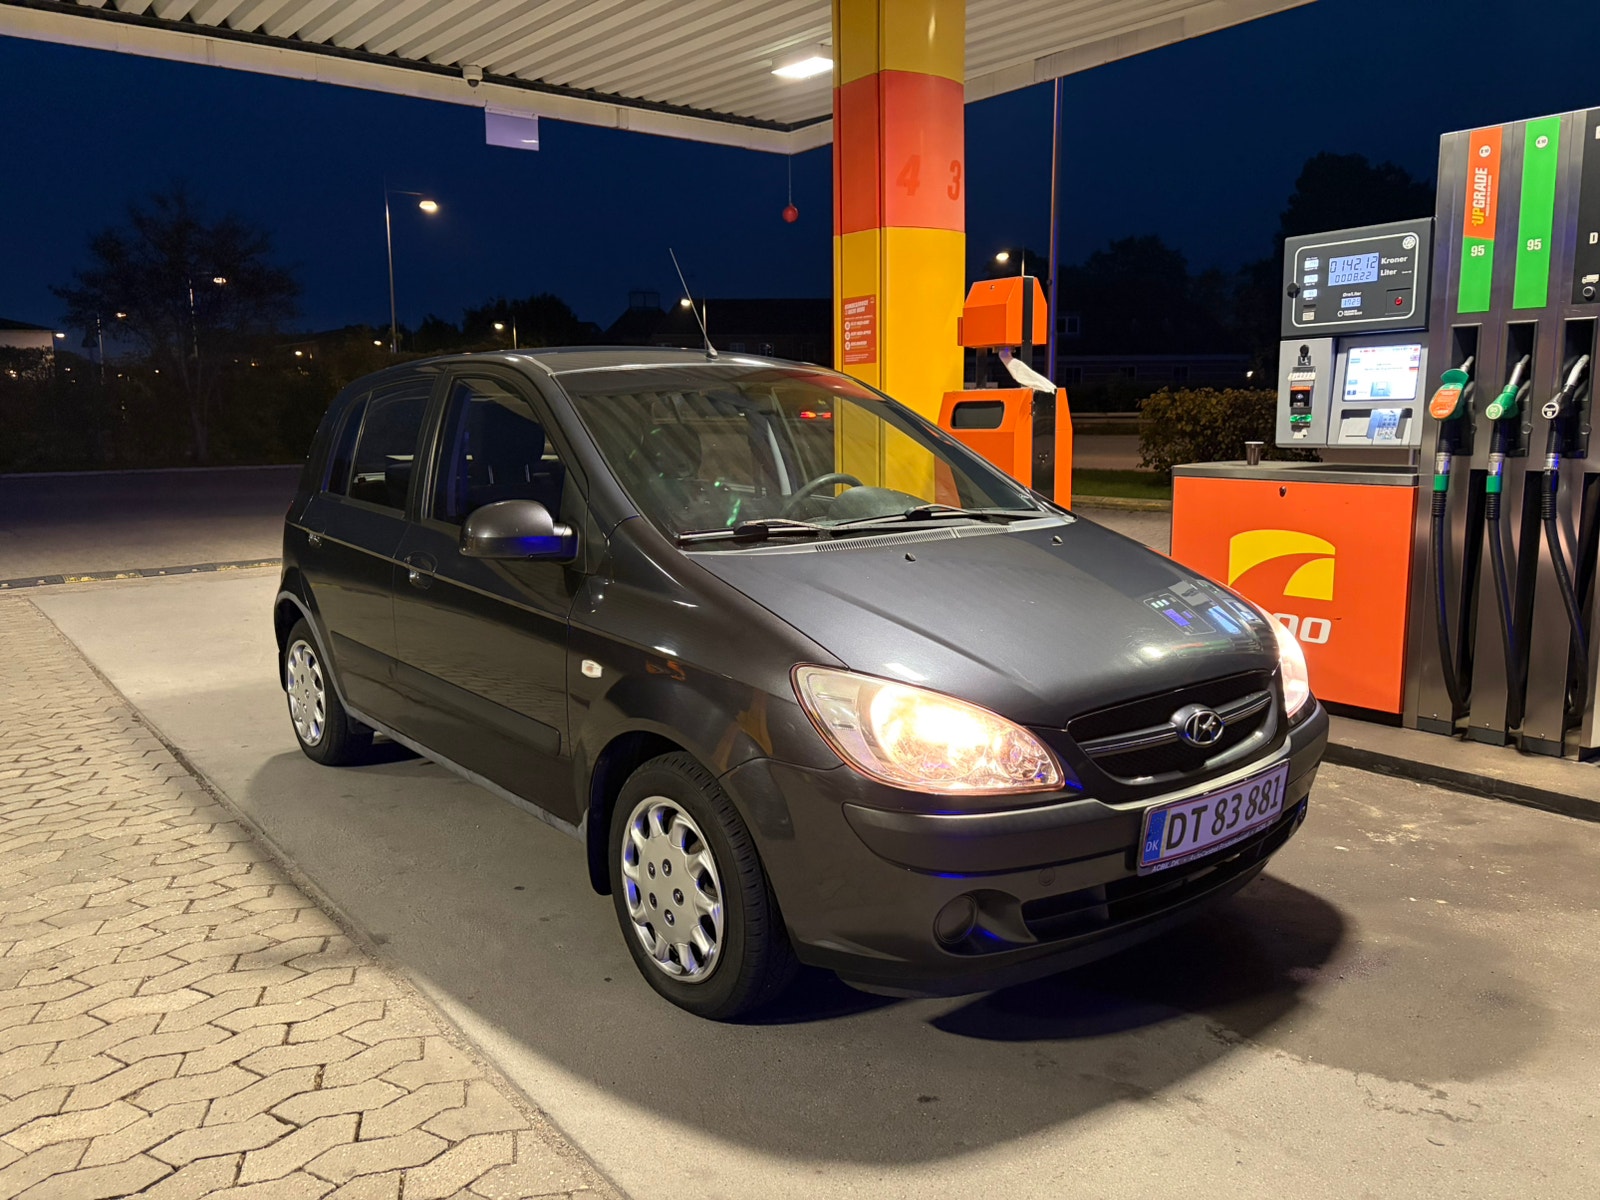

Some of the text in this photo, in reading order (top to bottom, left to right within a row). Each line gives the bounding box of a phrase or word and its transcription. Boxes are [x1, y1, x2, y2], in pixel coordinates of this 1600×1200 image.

[896, 154, 921, 197] 4
[947, 160, 961, 201] 3
[1472, 167, 1488, 226] UPGRADE
[1470, 245, 1485, 257] 95
[1526, 238, 1542, 251] 95
[1329, 255, 1378, 274] 0142.12
[1381, 255, 1408, 265] Kroner
[1380, 268, 1398, 277] Liter
[1166, 805, 1209, 850] DT
[1211, 793, 1243, 836] 83
[1244, 774, 1281, 821] 881
[1145, 839, 1159, 853] DK
